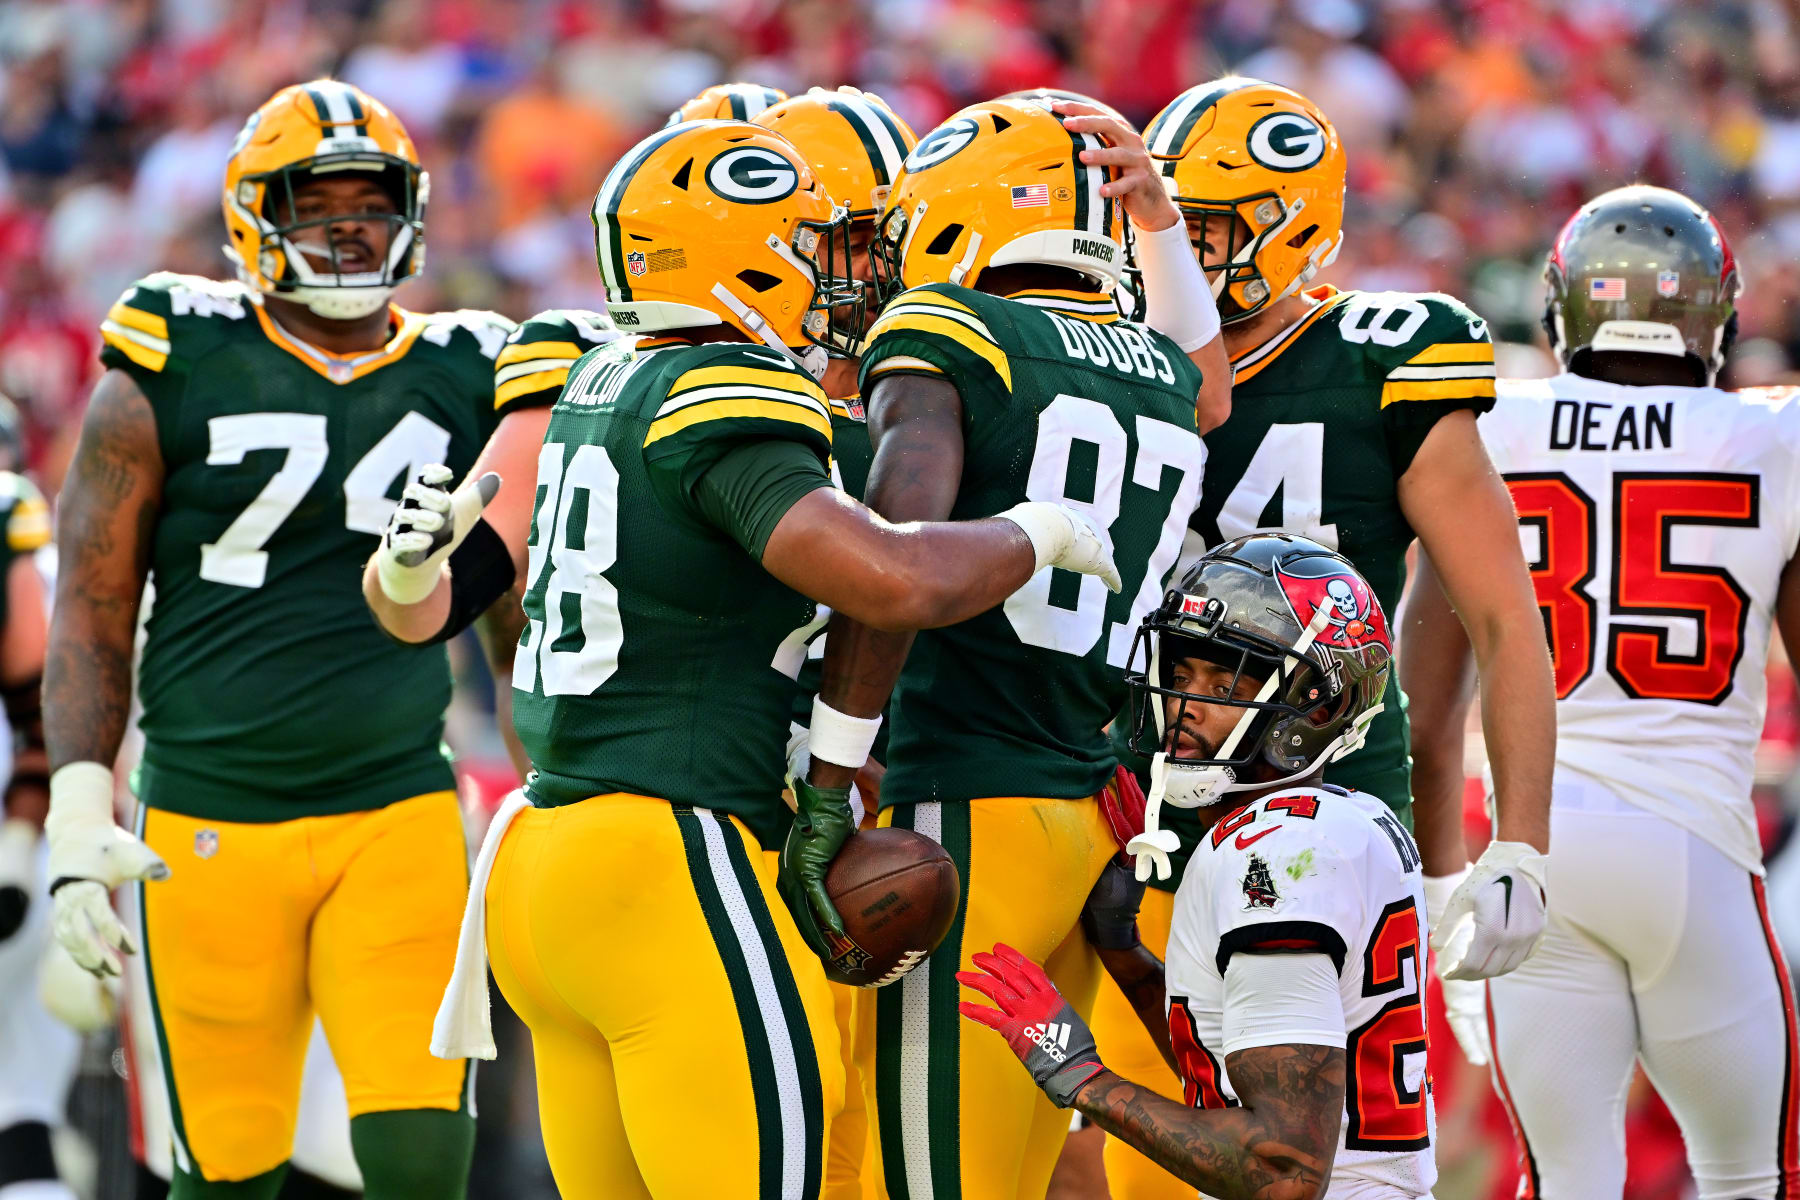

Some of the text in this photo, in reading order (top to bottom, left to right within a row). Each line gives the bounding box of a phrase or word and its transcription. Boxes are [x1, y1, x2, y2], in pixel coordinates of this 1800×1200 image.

[1250, 113, 1325, 169] G
[709, 148, 796, 200] G
[630, 261, 646, 273] NFL
[1072, 238, 1114, 263] PACKERS
[1041, 309, 1176, 386] DOUBS
[563, 350, 657, 406] DILLON
[1548, 400, 1674, 451] DEAN
[200, 411, 451, 589] 74
[1003, 393, 1202, 675] 87
[512, 442, 624, 697] 28
[1023, 1026, 1067, 1063] adidas
